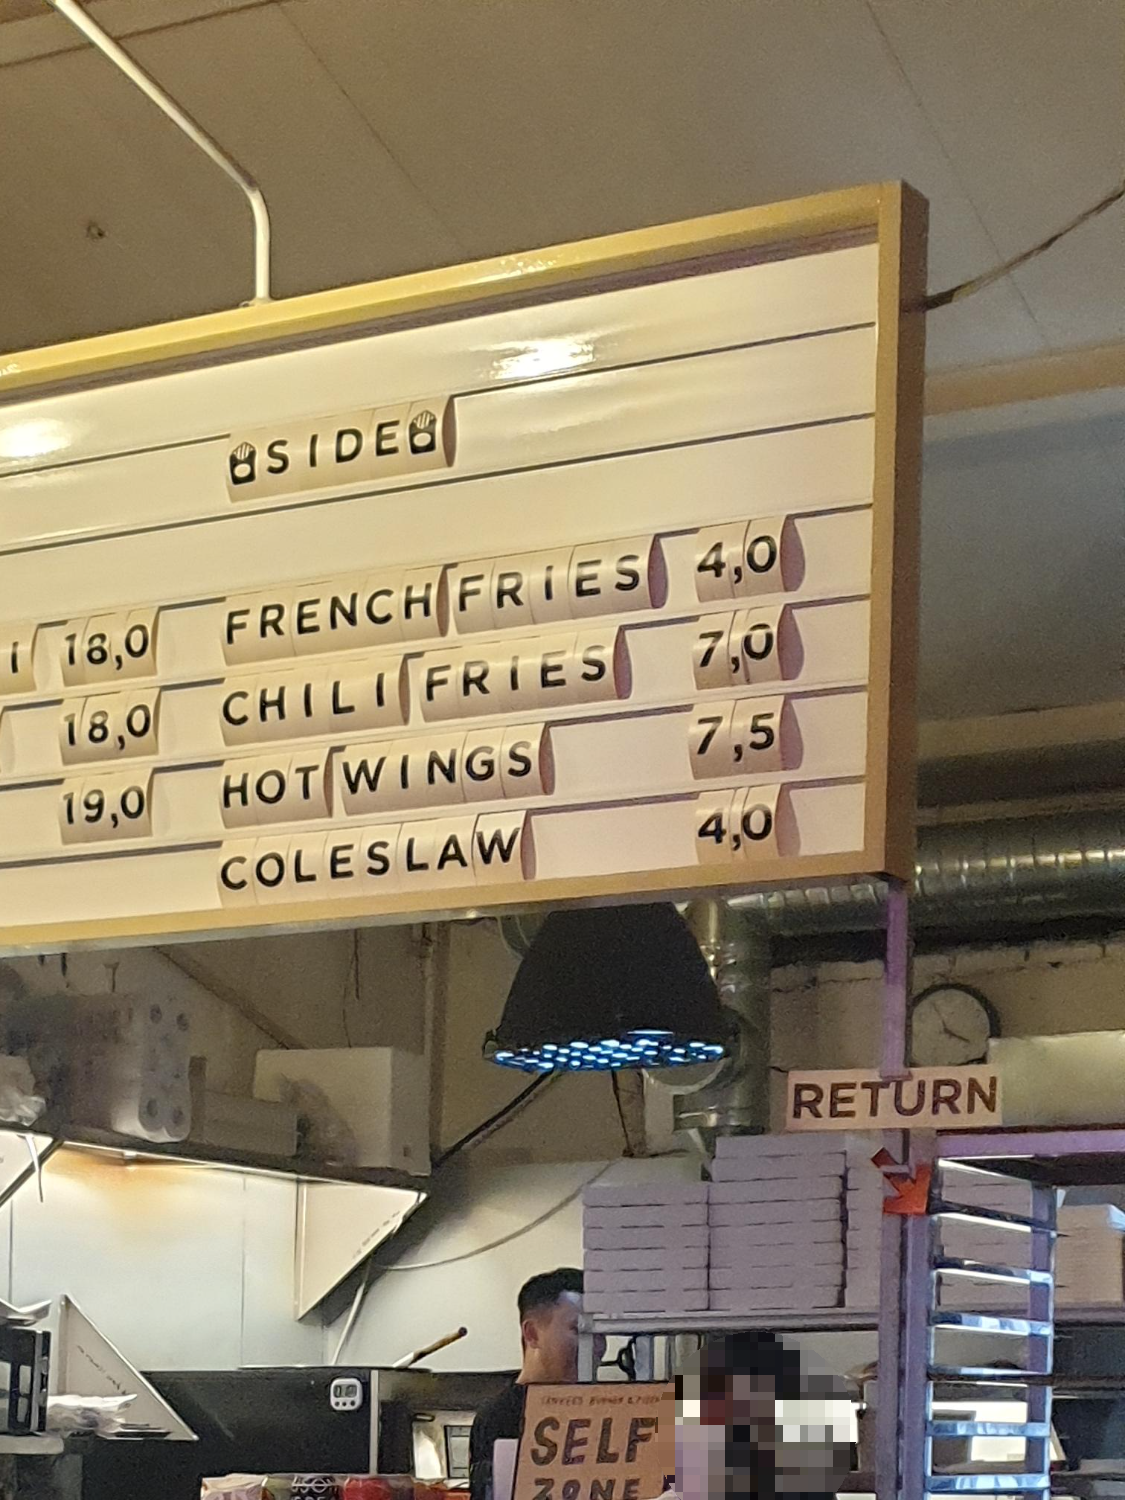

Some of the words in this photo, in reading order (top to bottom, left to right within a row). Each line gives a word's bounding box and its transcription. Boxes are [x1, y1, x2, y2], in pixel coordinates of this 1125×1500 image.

[267, 418, 400, 474] SIDE
[224, 580, 432, 645] FRENCH
[458, 554, 642, 610] FRIES
[223, 672, 386, 727] CHILI
[425, 644, 607, 700] FRIES
[223, 765, 319, 808] HOT
[341, 741, 534, 793] WINGS
[221, 826, 522, 890] COLESLAW
[792, 1076, 997, 1119] RETURN
[530, 1415, 658, 1466] SELF
